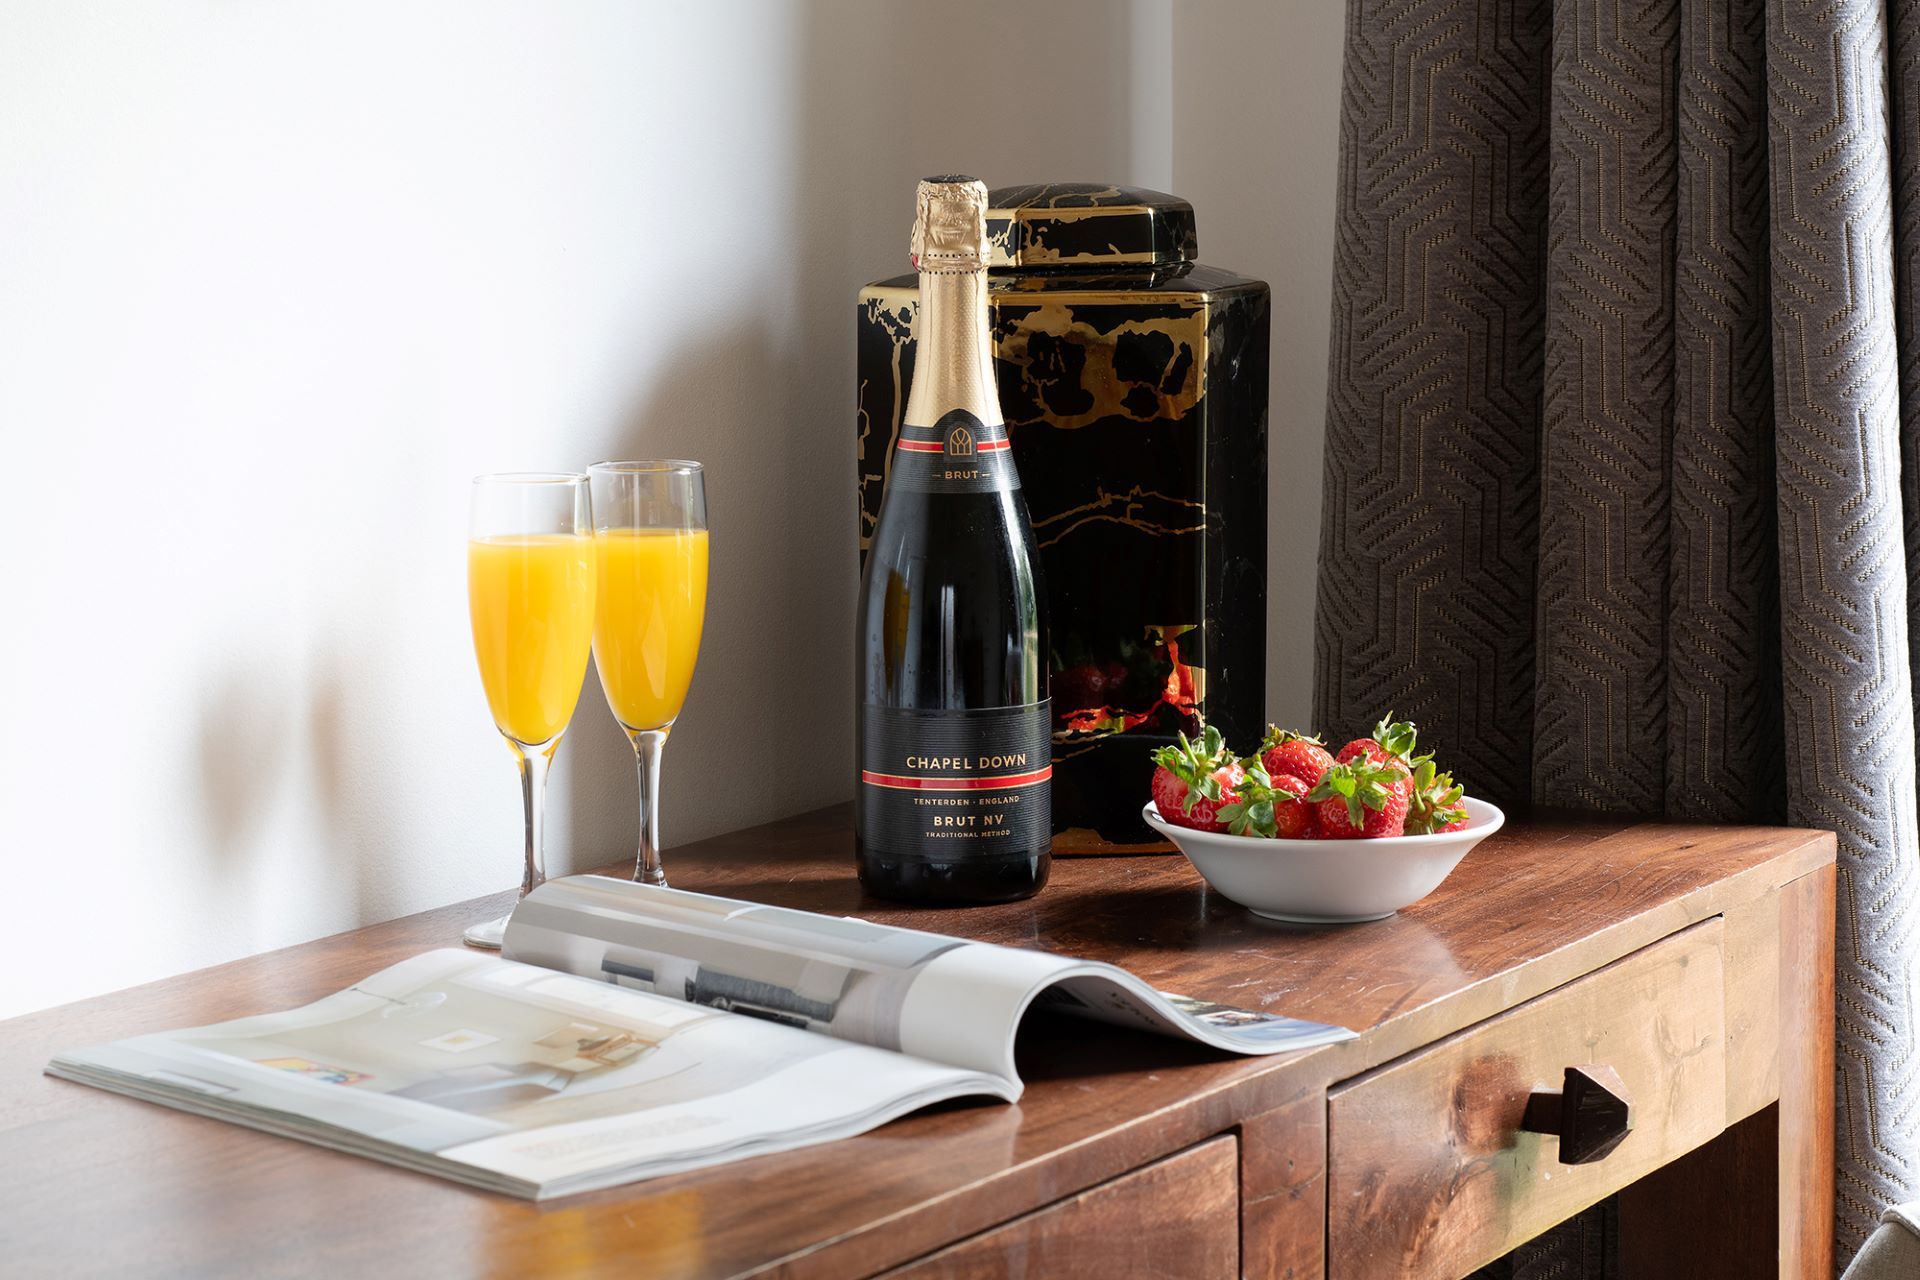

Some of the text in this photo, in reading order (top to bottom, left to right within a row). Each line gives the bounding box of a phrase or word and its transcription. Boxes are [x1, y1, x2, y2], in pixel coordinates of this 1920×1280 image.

[945, 471, 978, 479] BRUT
[906, 753, 1026, 769] CHAPEL DOWN
[914, 795, 1019, 806] TENTERDEN ENGLAND
[934, 814, 1004, 826] BRUT NV
[981, 829, 1010, 837] METHOD
